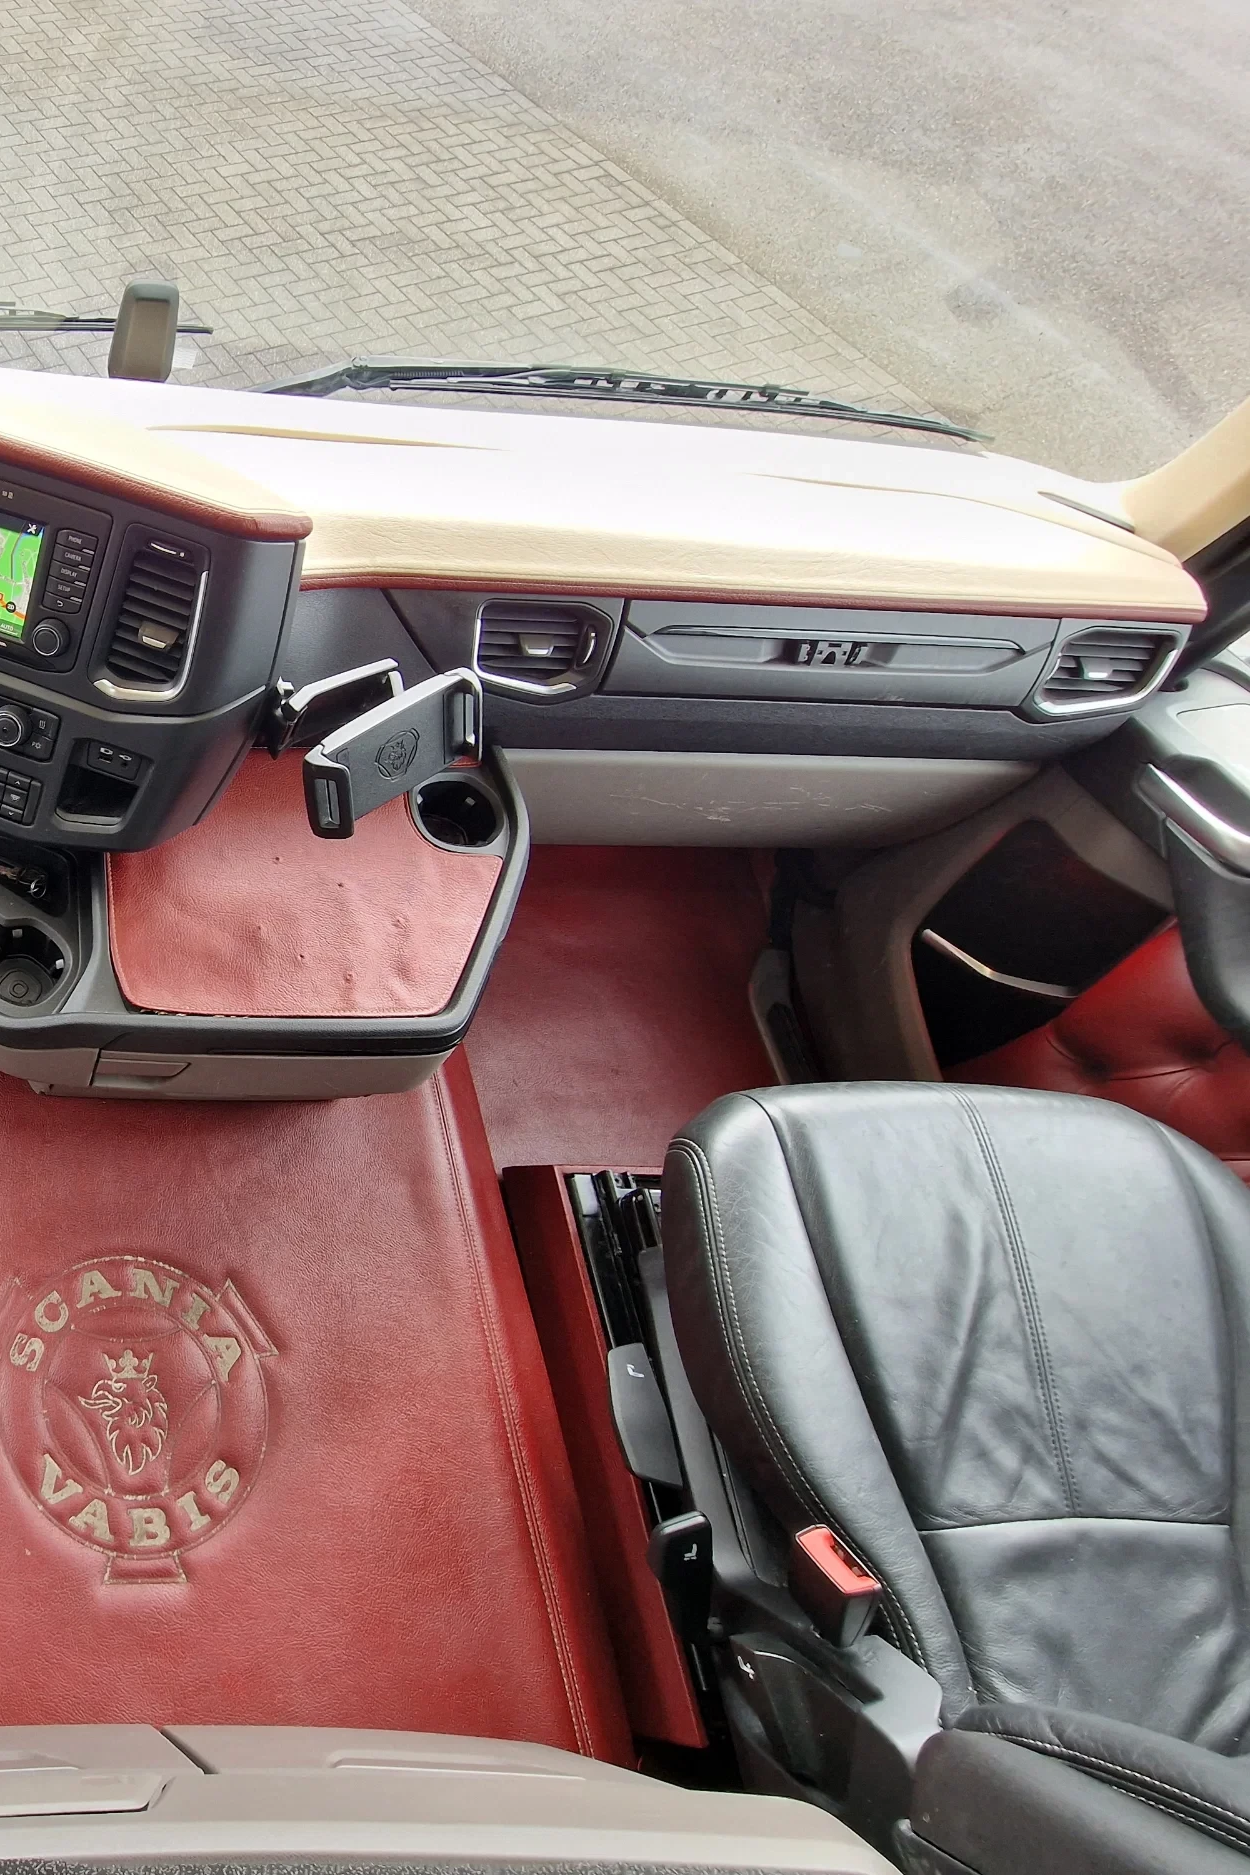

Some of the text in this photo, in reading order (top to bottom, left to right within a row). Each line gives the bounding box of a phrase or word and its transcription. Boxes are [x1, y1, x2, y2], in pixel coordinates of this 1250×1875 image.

[68, 535, 83, 545] PHONE
[64, 551, 82, 562] CAMERA
[60, 567, 78, 578] DISPLAY
[57, 584, 71, 592] SETUP
[10, 1268, 242, 1382] SCANIA
[40, 1452, 240, 1547] VABIS
